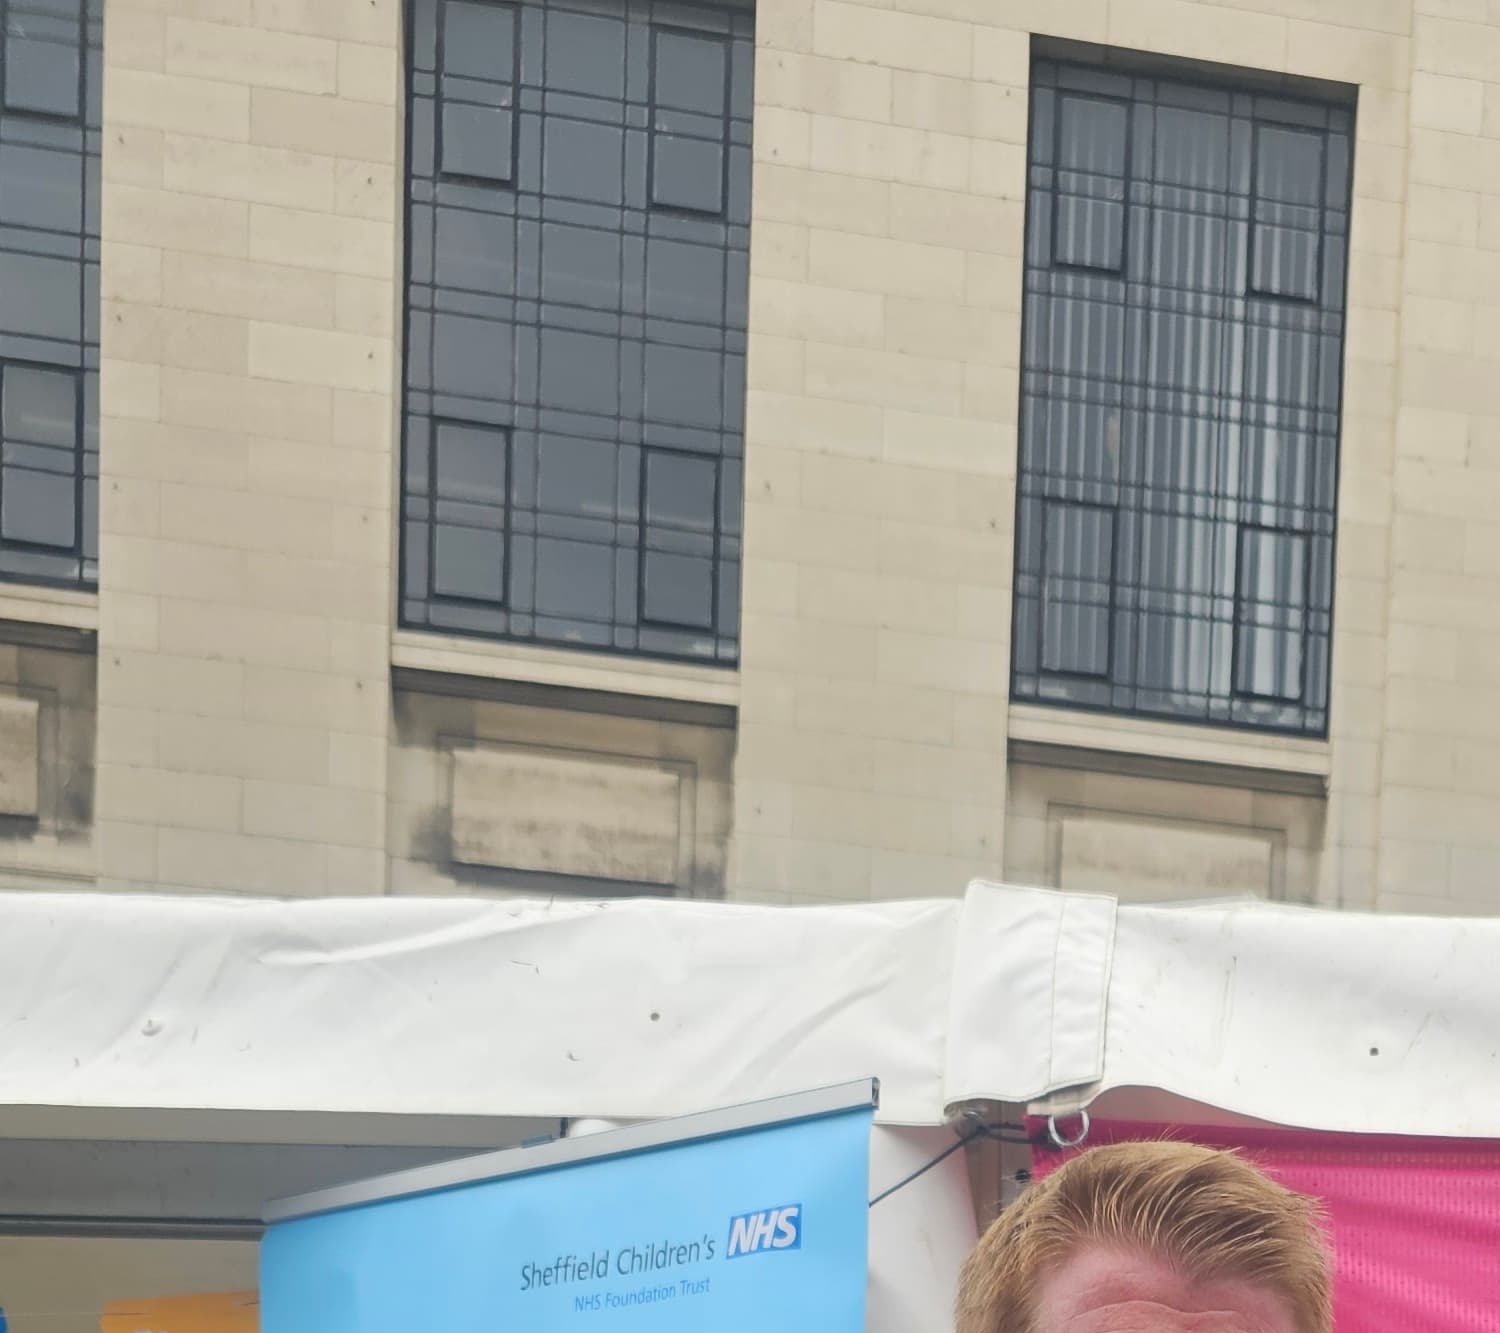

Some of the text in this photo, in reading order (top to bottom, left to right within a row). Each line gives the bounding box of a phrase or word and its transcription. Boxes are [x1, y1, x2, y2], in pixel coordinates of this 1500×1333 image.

[520, 1206, 800, 1291] Sheffield Children's NHS
[574, 1277, 711, 1313] NHS Foundation Trust
